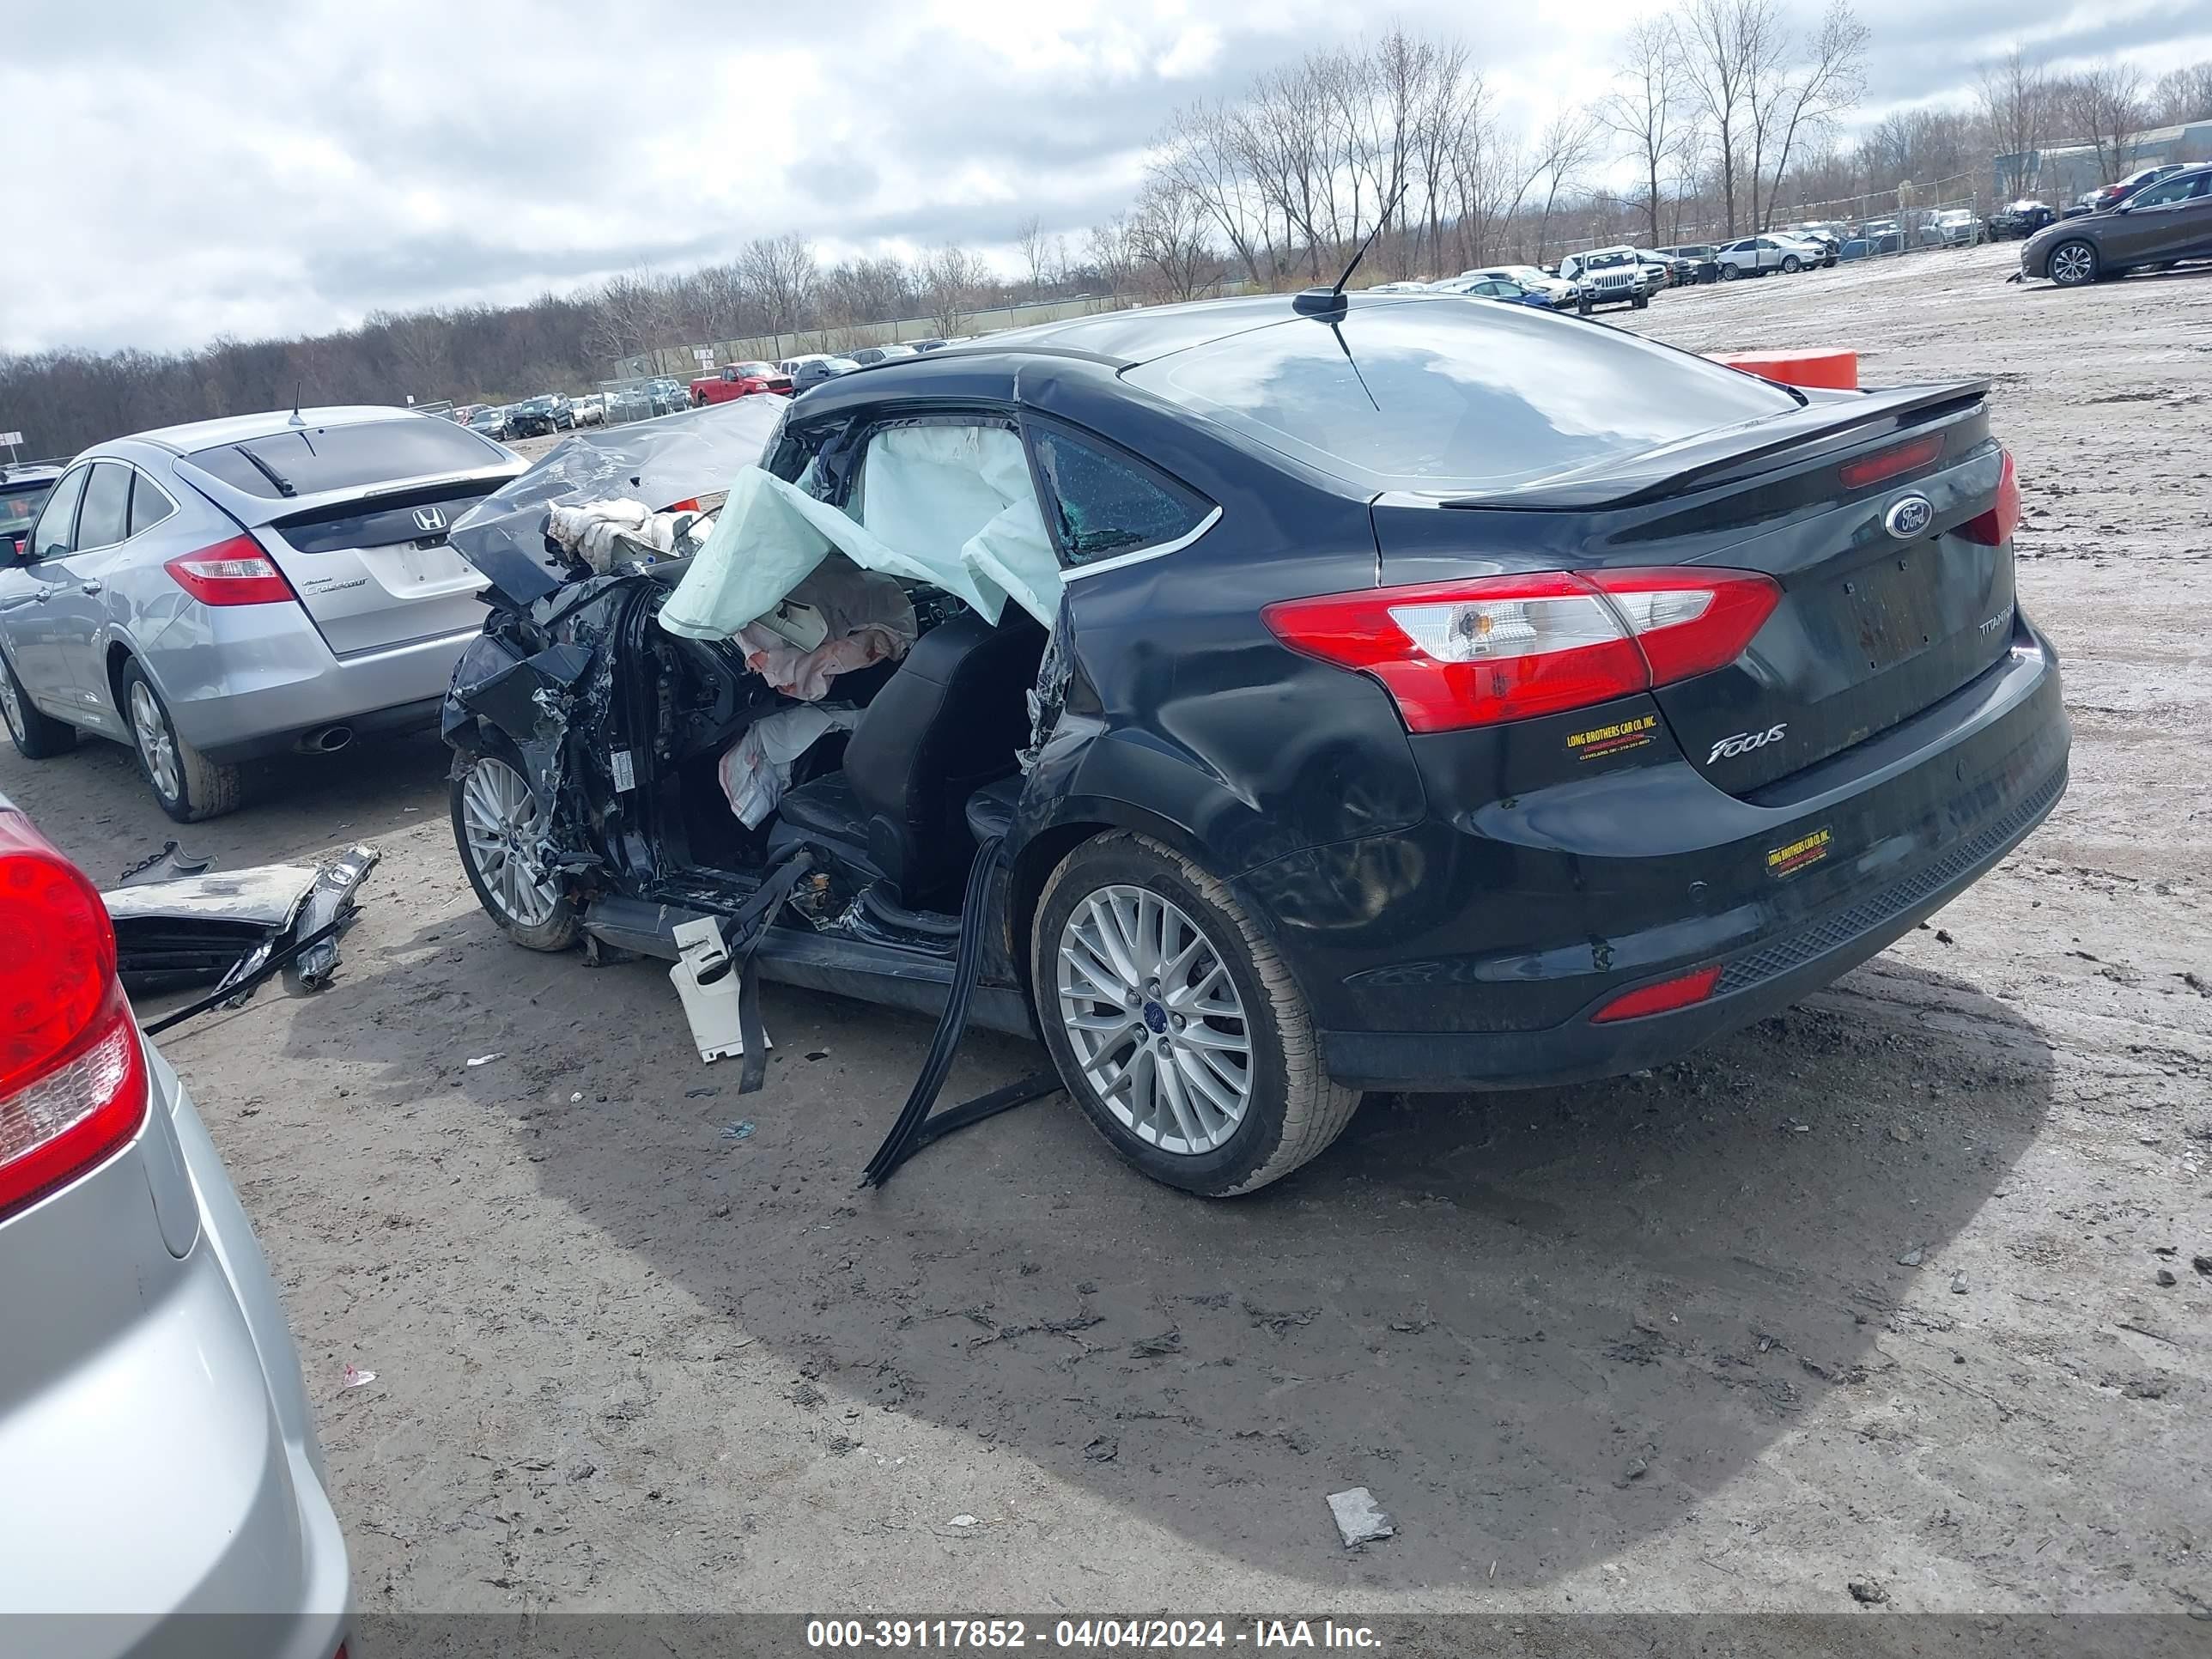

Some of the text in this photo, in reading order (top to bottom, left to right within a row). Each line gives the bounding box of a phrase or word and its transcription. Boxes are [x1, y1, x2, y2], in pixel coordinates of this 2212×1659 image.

[1902, 505, 1924, 531] Ford
[1567, 733, 1586, 747] LONG
[1586, 725, 1620, 742] BROTHERS
[1620, 722, 1633, 734] CAR
[1633, 720, 1644, 730] CO.
[1768, 851, 1782, 866] LONG
[1781, 841, 1805, 860] BROTHERS
[1804, 836, 1814, 849] CAR
